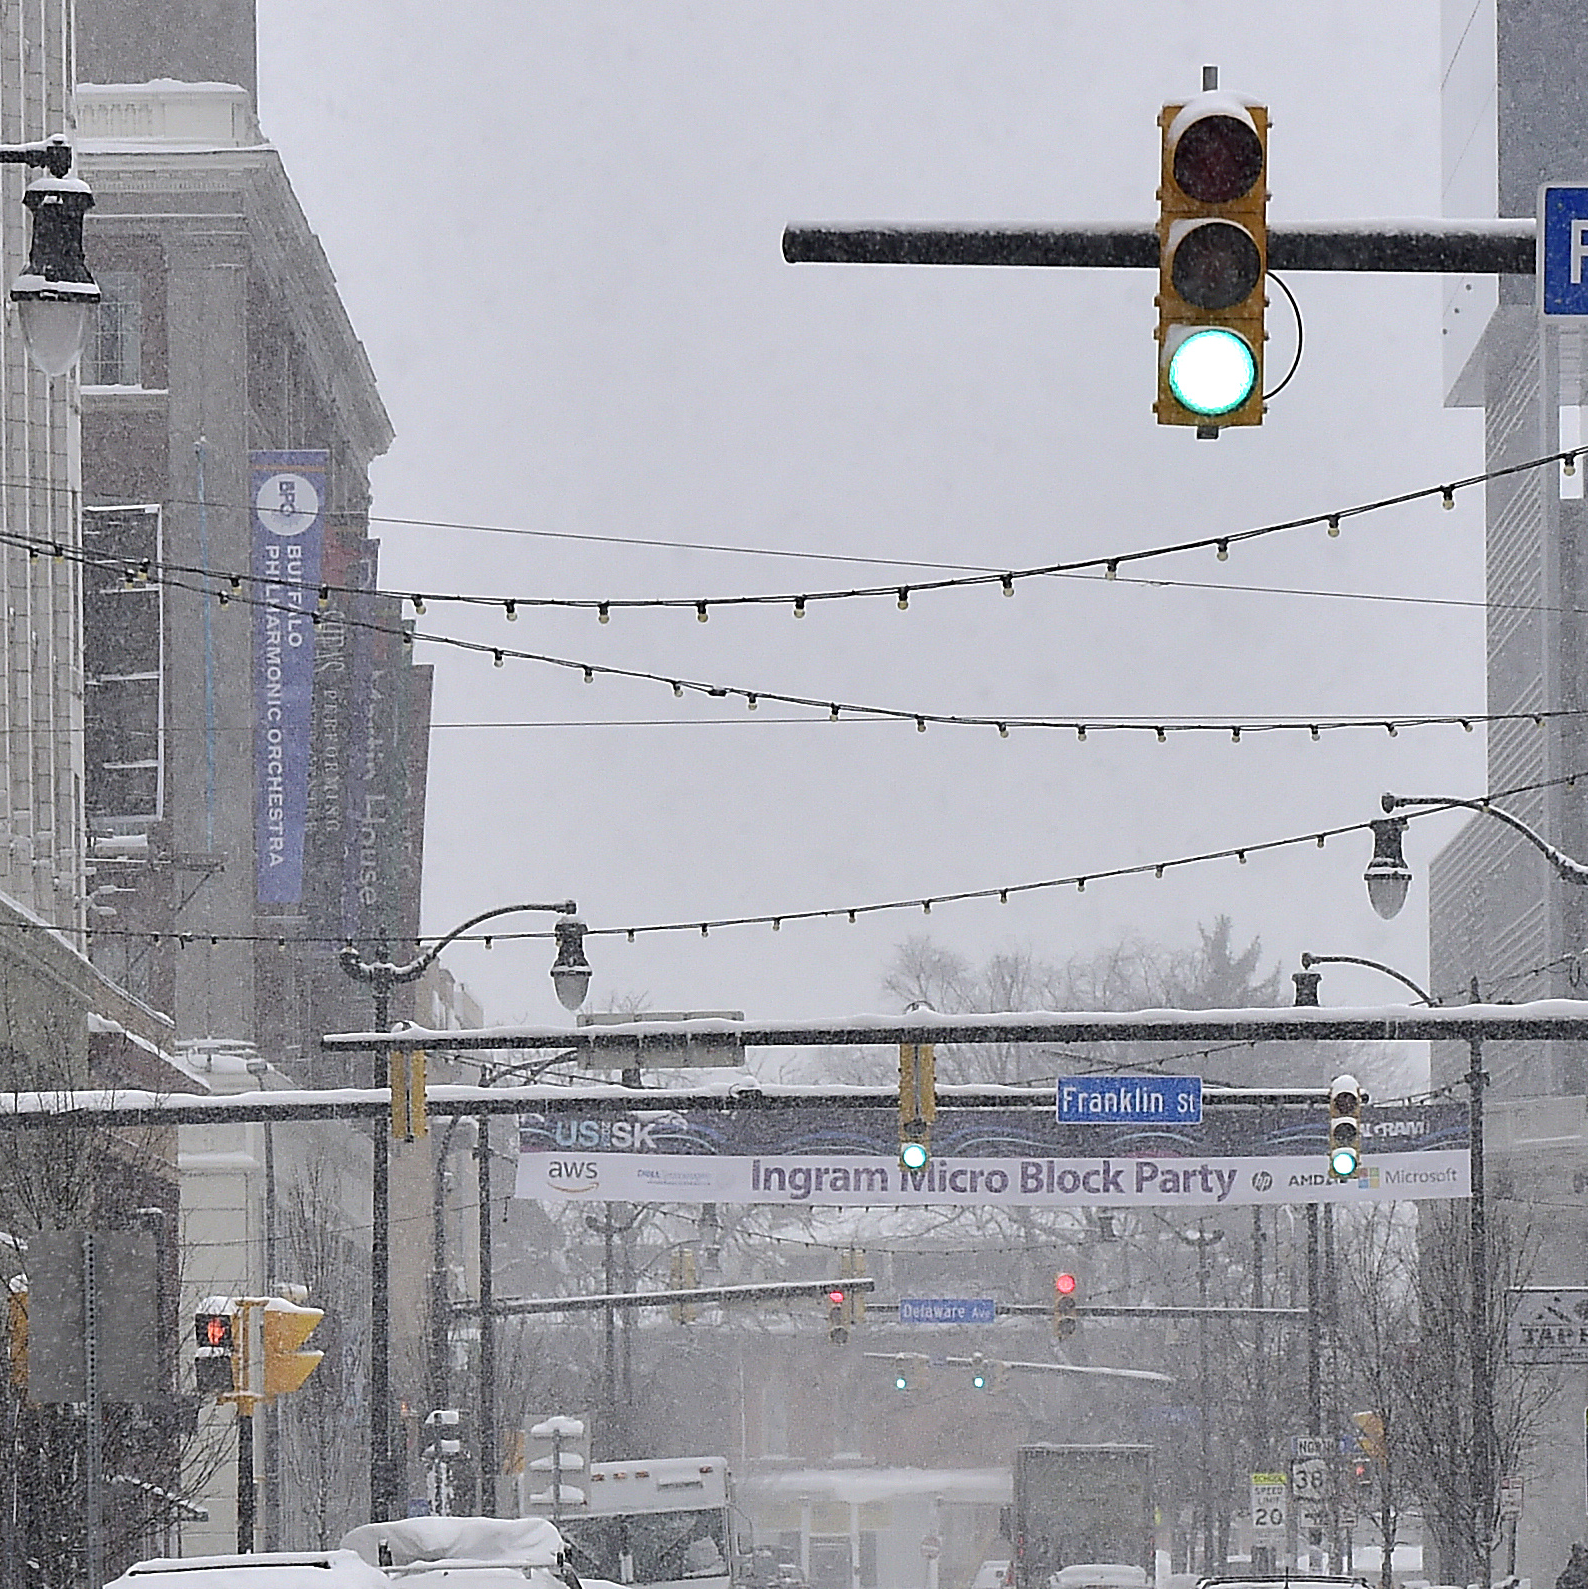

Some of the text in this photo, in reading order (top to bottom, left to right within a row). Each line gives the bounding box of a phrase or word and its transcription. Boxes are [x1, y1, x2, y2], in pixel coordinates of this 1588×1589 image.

[266, 728, 284, 867] ORCHESTRA
[1063, 1087, 1196, 1113] Franklin St
[548, 1161, 598, 1179] aws
[751, 1160, 889, 1199] Ingram
[901, 1160, 1009, 1194] Micro
[1020, 1160, 1126, 1194] Block
[1135, 1160, 1237, 1202] Party
[1385, 1167, 1458, 1184] Microsoft
[904, 1304, 966, 1319] Delaware
[1255, 1508, 1282, 1526] 20
